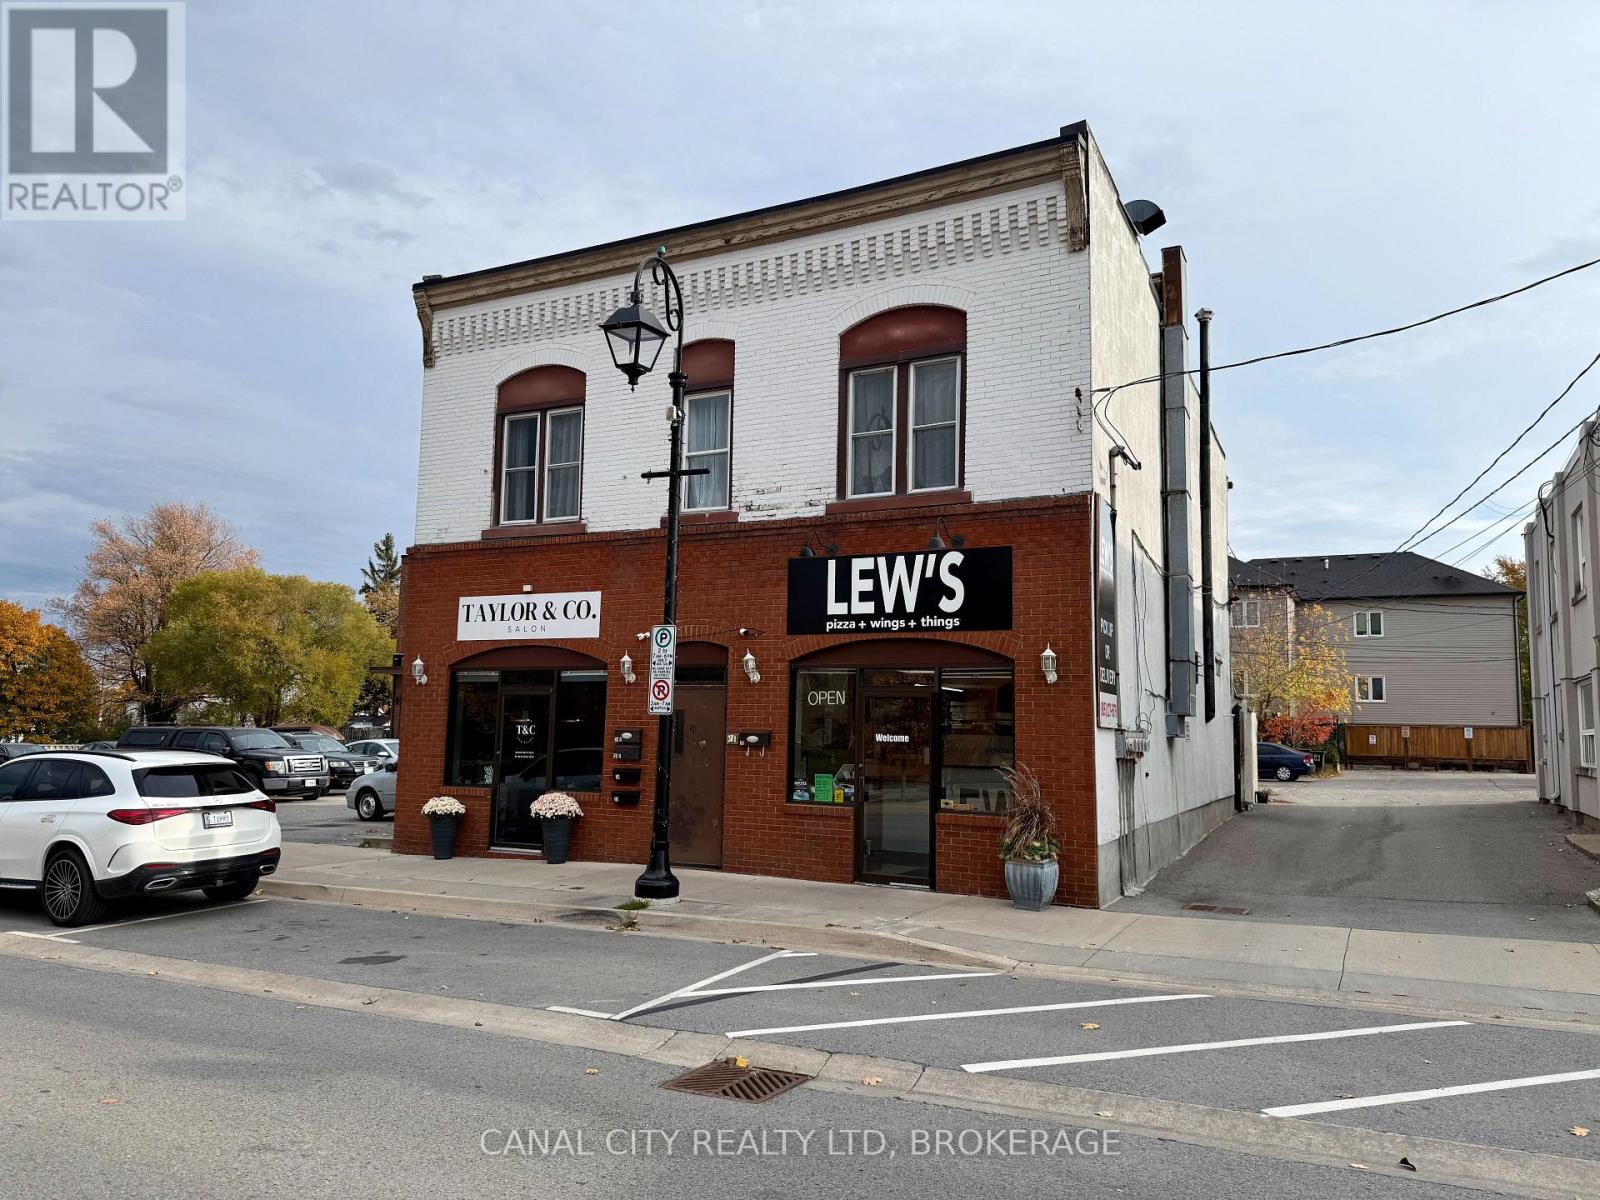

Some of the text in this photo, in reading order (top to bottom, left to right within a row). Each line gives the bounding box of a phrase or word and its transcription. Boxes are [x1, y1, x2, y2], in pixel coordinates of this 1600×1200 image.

[827, 550, 965, 615] LEW'S
[461, 599, 597, 623] TAYLOR & CO.
[507, 625, 547, 633] SALON
[826, 618, 856, 632] pizza
[870, 617, 906, 630] wings
[920, 615, 960, 630] things
[808, 690, 846, 706] OPEN
[515, 724, 536, 735] T&C
[875, 733, 910, 743] Welcome
